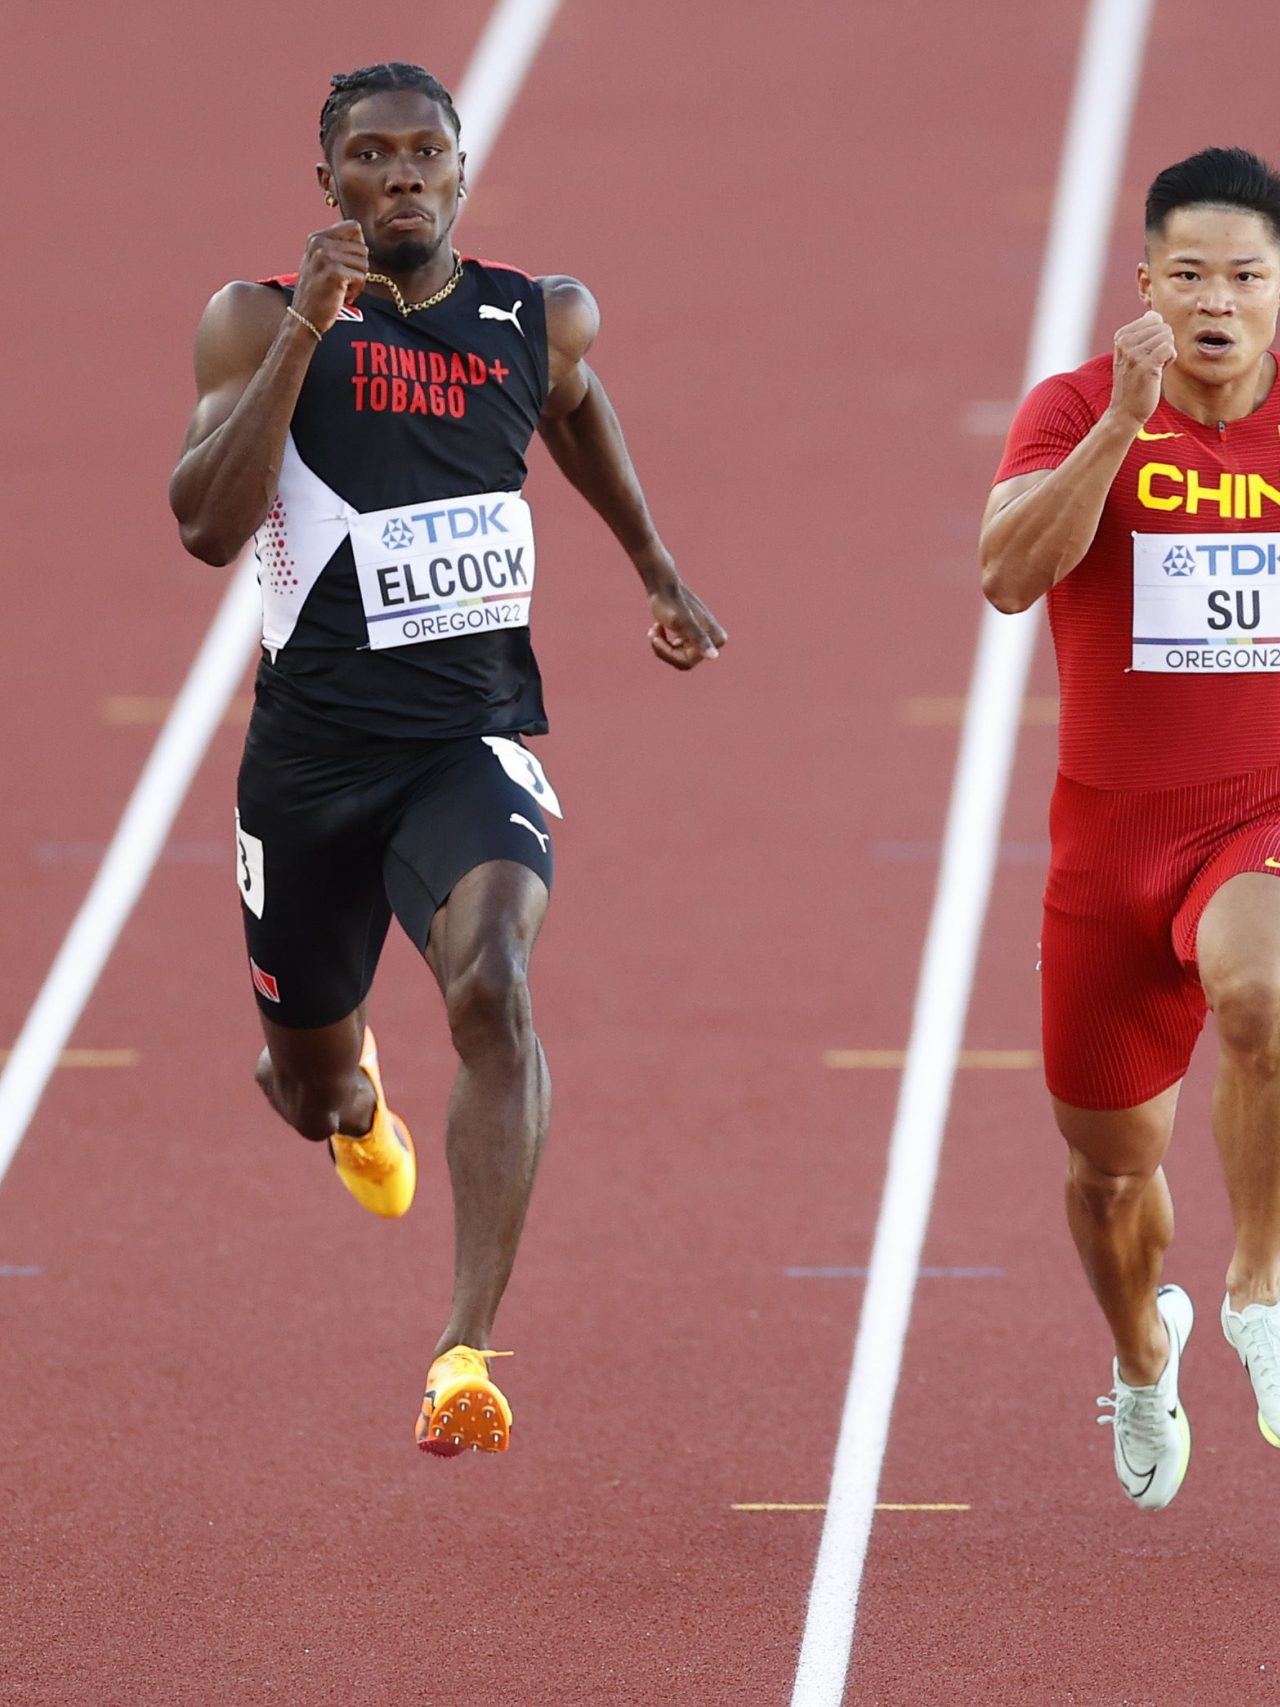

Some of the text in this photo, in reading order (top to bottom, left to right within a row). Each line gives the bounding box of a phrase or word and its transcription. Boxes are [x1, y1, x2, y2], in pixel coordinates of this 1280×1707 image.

[351, 341, 509, 385] TRINIDAD+
[352, 376, 465, 418] TOBAGO
[412, 503, 508, 543] TDK
[376, 546, 528, 607] ELCOCK
[402, 604, 521, 638] OREGON22
[1207, 590, 1260, 630] SU
